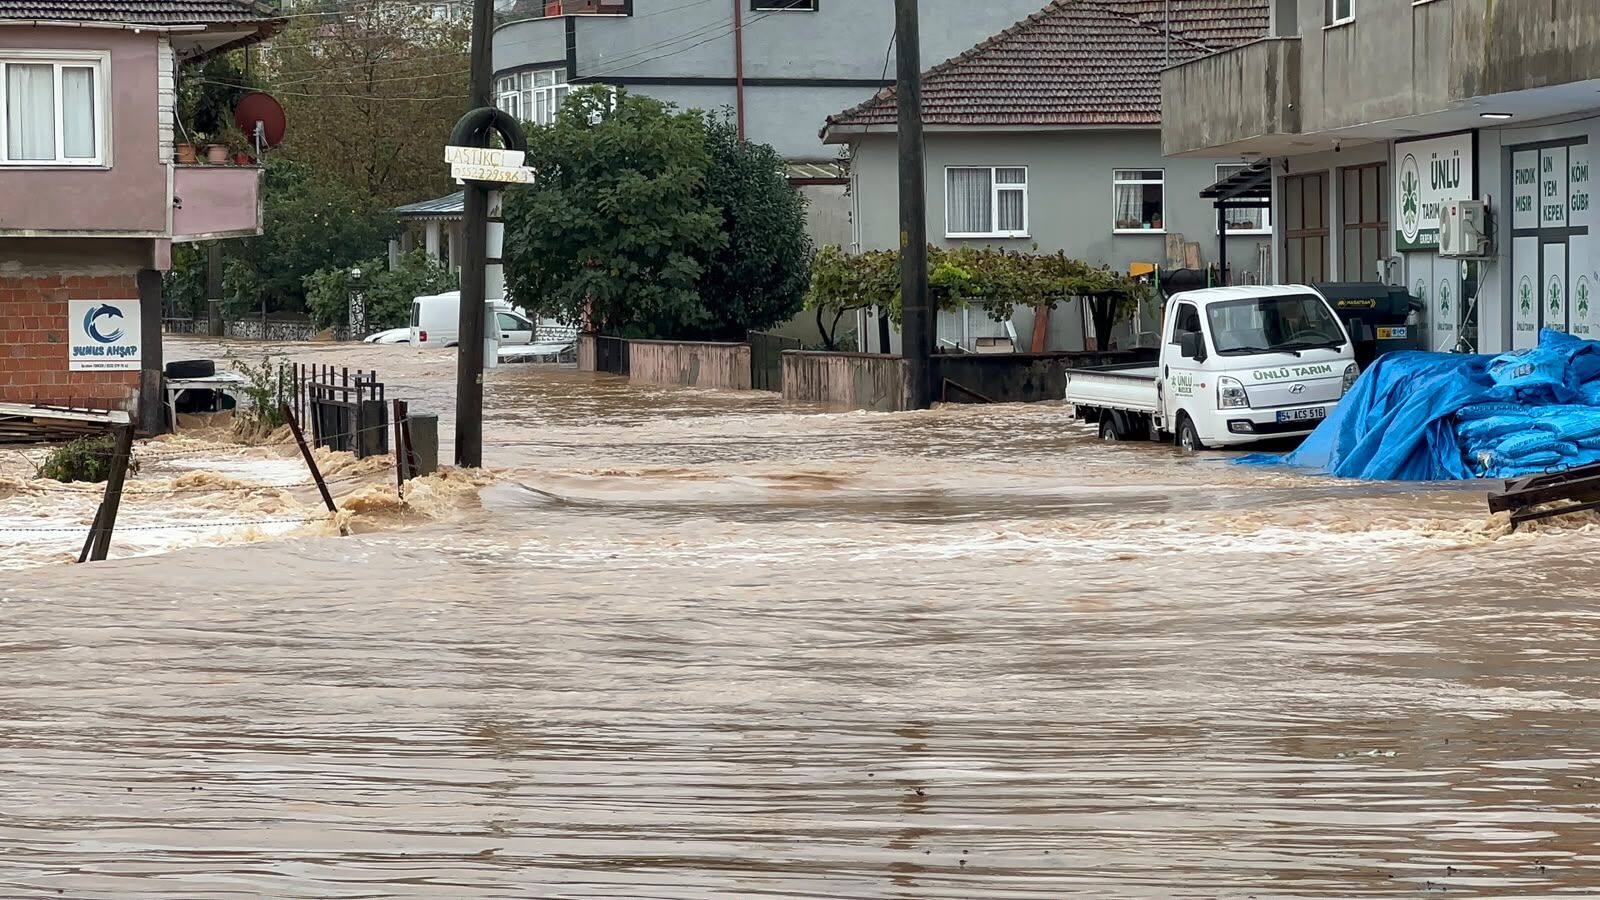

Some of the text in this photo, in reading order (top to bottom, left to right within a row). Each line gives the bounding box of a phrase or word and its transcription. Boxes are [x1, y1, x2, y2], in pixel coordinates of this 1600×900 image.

[1431, 149, 1460, 190] ÜNLÜ
[1543, 156, 1553, 173] UN
[1515, 168, 1536, 185] FINDIK
[1543, 180, 1557, 197] YEM
[1422, 203, 1440, 219] TARIM
[1515, 195, 1532, 212] MISIR
[1543, 204, 1564, 221] KEPEK
[73, 345, 137, 357] YUNUS AHŞAP
[1177, 372, 1193, 387] ÜNLÜ
[1253, 364, 1332, 381] ÜNLÜ TARIM
[1281, 408, 1323, 420] 54 ACS 516
